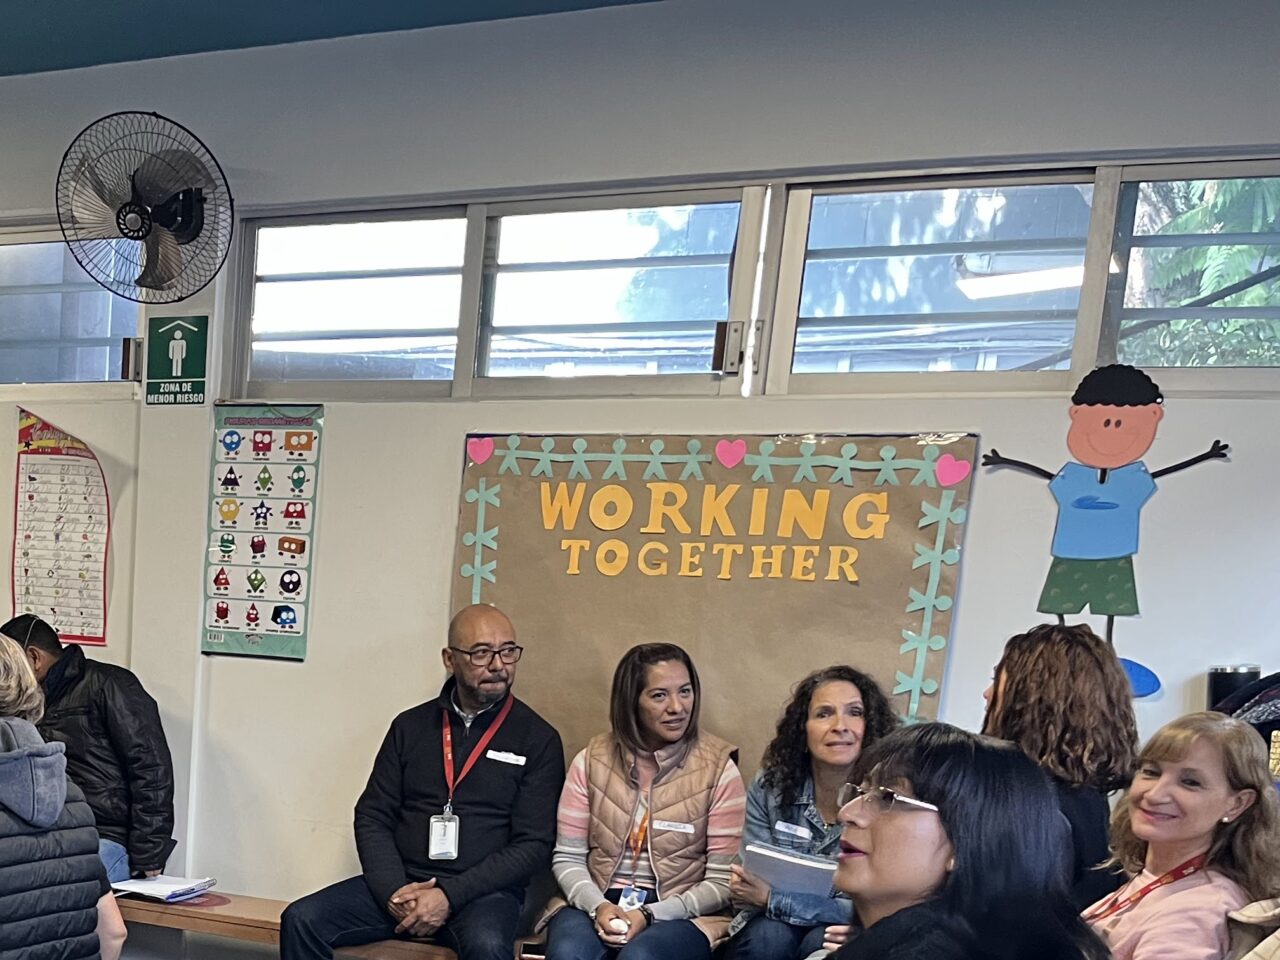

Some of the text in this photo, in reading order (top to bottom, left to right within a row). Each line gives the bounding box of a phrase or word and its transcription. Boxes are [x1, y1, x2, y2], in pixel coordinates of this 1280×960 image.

[147, 393, 204, 403] MENOR RIESGO
[159, 382, 192, 392] ZONA DE
[540, 482, 891, 540] WORKING
[561, 538, 860, 583] TOGETHER
